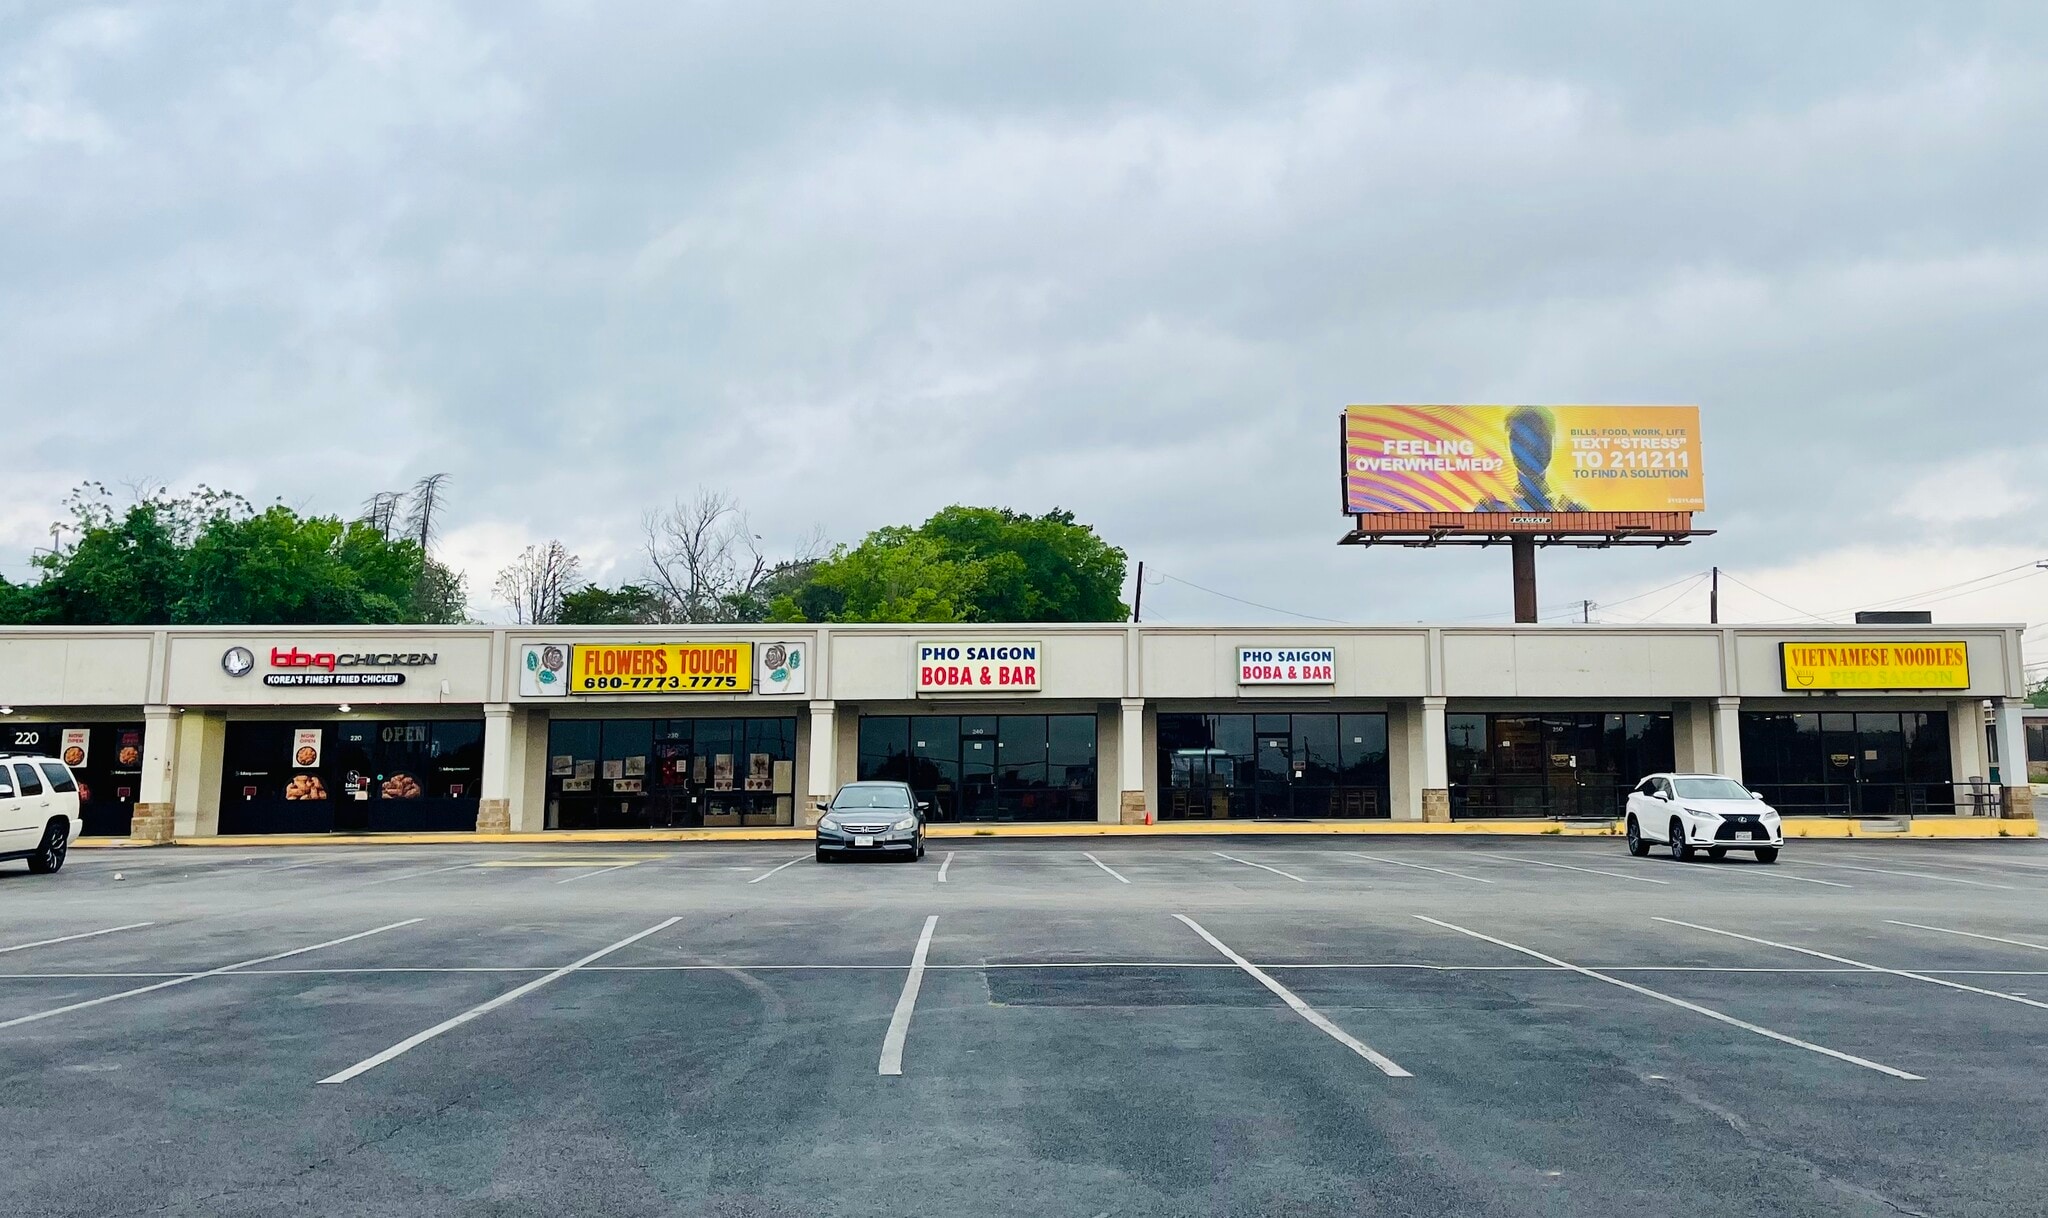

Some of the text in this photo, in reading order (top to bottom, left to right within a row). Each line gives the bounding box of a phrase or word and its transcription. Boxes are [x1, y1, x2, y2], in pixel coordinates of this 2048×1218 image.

[1383, 439, 1474, 455] FEELING
[1571, 438, 1611, 449] TEXT
[1355, 457, 1504, 472] OVERWHELMED?
[1572, 451, 1688, 468] TO 211211
[1573, 469, 1688, 478] TO FIND A SOLUTION
[337, 653, 438, 666] CHICKEN
[921, 647, 1036, 660] PHO SAIGON
[1242, 651, 1332, 662] PHO SAIGON
[1791, 647, 1963, 667] VIETNAMESE NOODLES
[584, 649, 738, 675] FLOWERS TOUCH
[267, 674, 399, 684] KOREA'S FINEST FRIED CHICKEN
[921, 666, 1036, 686] BOBA & BAR
[1243, 665, 1332, 679] BOBA & BAR
[1830, 670, 1953, 685] PHO SAIGON
[15, 732, 39, 745] 220
[382, 726, 427, 742] OPEN
